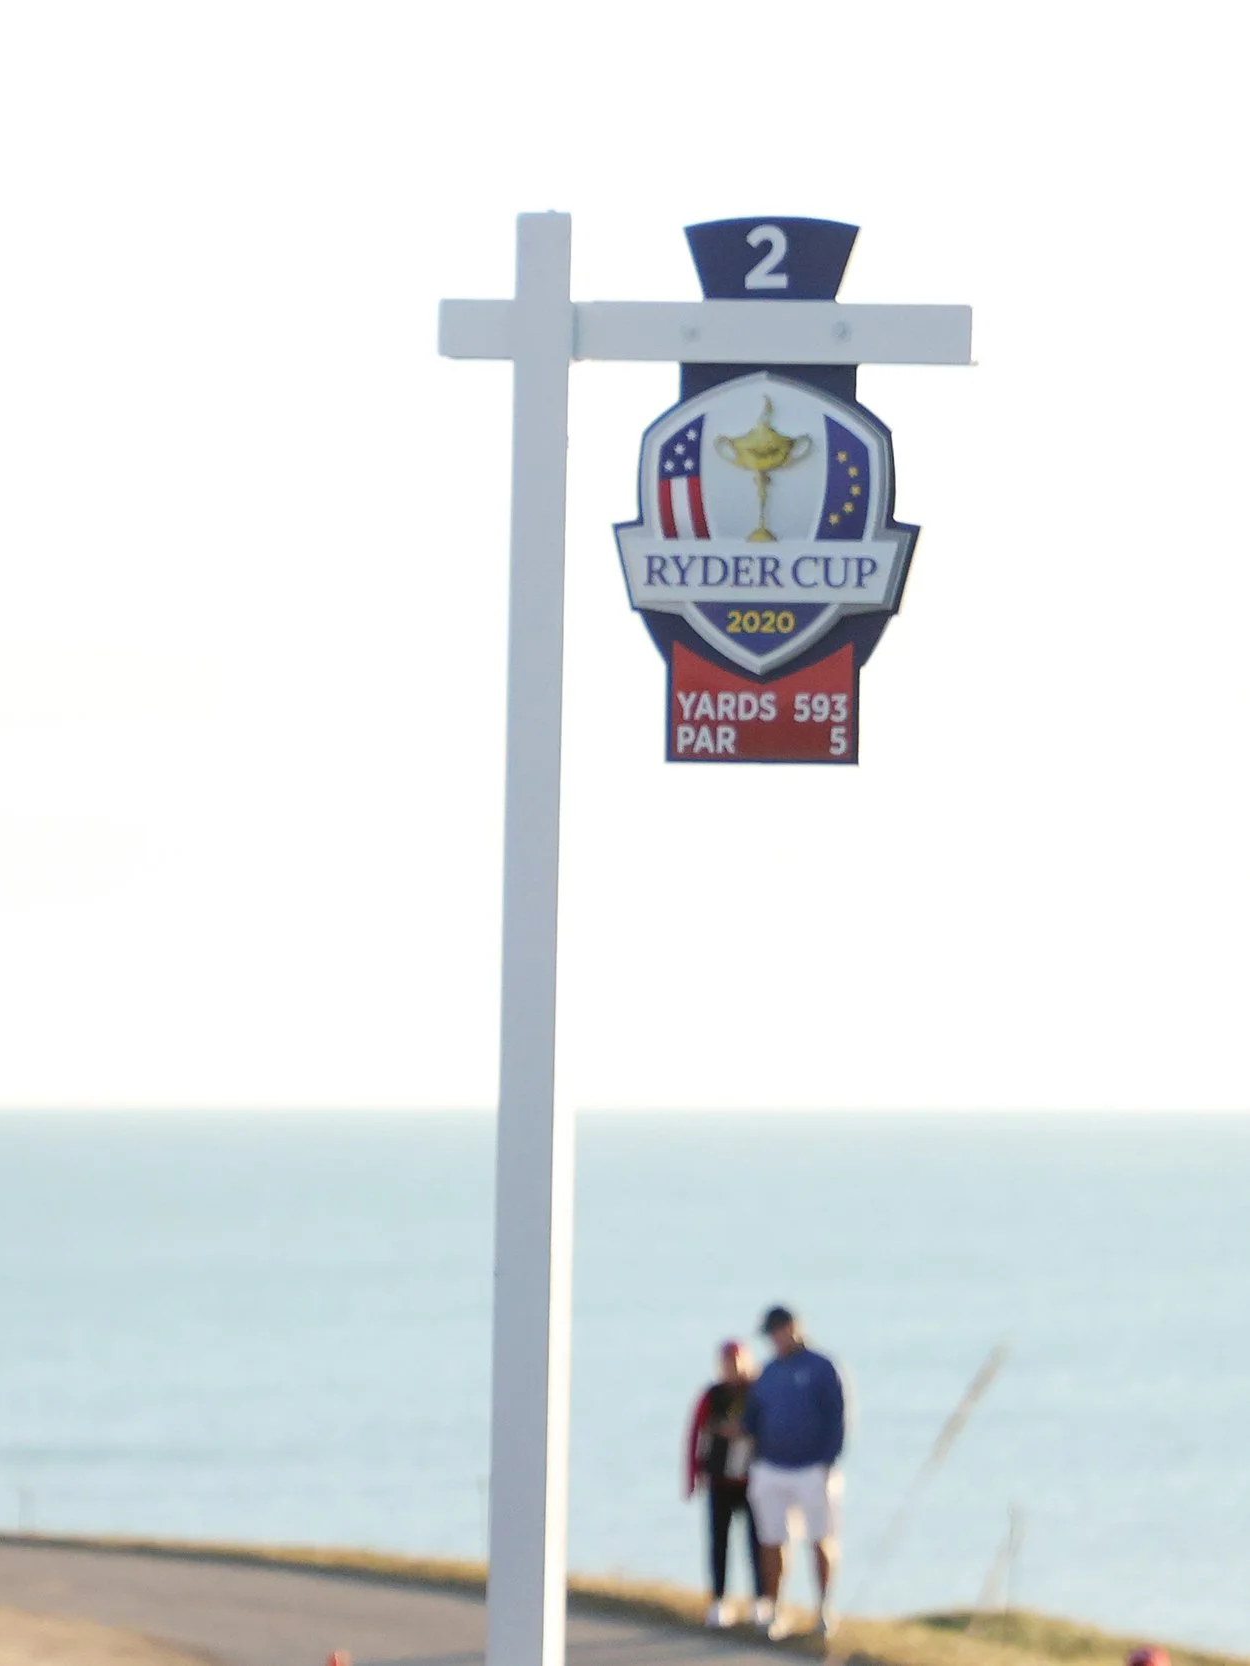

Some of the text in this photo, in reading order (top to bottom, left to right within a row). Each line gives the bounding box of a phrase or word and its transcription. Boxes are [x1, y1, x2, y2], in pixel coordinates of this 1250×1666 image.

[744, 224, 789, 290] 2
[643, 554, 878, 589] RYDER CUP
[726, 610, 796, 634] 2020
[676, 691, 849, 723] YARDS 593
[676, 725, 848, 755] PAR 5
